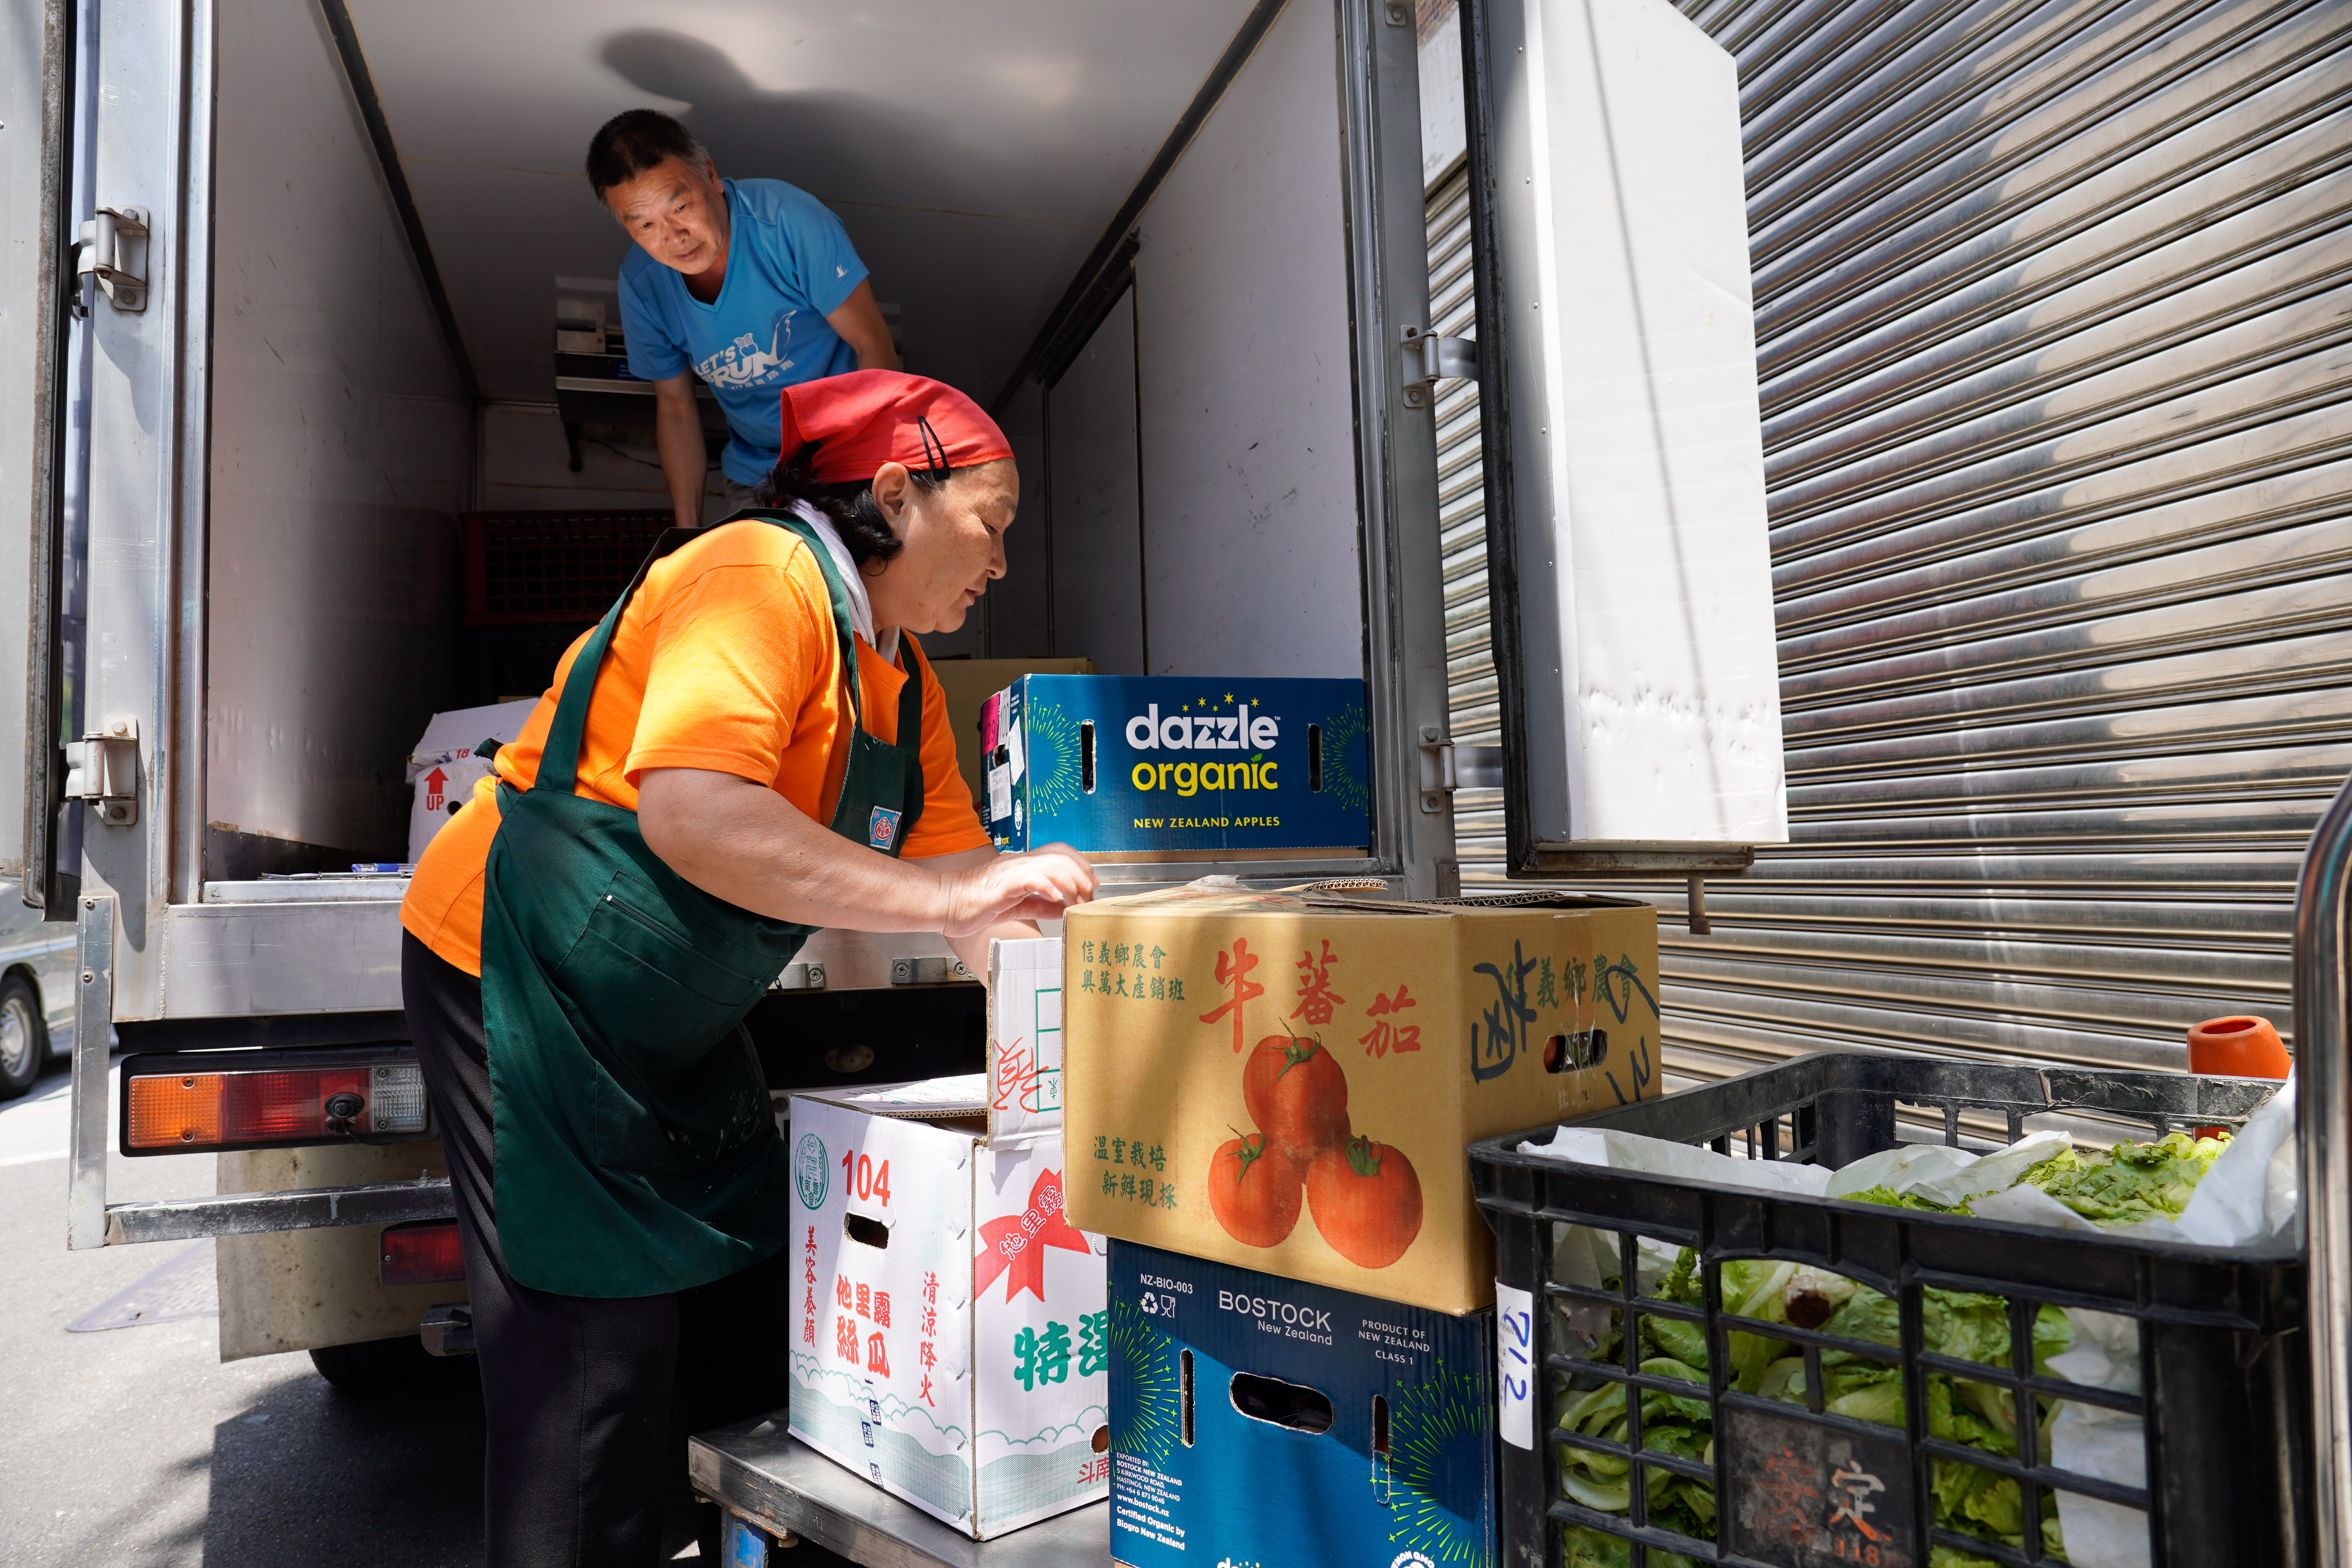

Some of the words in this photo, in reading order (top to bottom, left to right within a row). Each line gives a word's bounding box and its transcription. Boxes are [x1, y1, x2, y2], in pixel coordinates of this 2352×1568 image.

[695, 346, 735, 376] LET'S
[1126, 703, 1279, 750] dazzle
[457, 749, 470, 759] 18
[1132, 753, 1278, 797] organic
[427, 796, 444, 810] UP
[1134, 818, 1164, 829] NEW
[1170, 817, 1229, 828] ZEALAND
[1235, 816, 1280, 827] APPLES
[1082, 940, 1167, 970] 信義鄉農會
[1082, 969, 1185, 1001] 奧萬大產銷班
[1200, 937, 1421, 1059] 牛蕃茄
[1094, 1136, 1167, 1171] 溫室栽培
[842, 1149, 890, 1207] 104
[1102, 1169, 1178, 1210] 新鮮現採
[804, 1225, 817, 1348] 美容養顏
[1140, 1273, 1193, 1294] NZ-BIO-003
[1219, 1290, 1332, 1332] BOSTOCK
[919, 1271, 940, 1408] 清涼降火
[1258, 1320, 1281, 1334] New
[1285, 1326, 1332, 1346] Zealand
[1359, 1330, 1380, 1342] NEW
[1384, 1336, 1430, 1352] ZEALAND
[1362, 1319, 1408, 1336] PRODUCT
[1412, 1329, 1425, 1339] OF
[837, 1314, 890, 1379] 絲瓜
[1375, 1350, 1405, 1363] CLASS
[1409, 1357, 1413, 1365] 1
[1116, 1452, 1141, 1465] EXPORTED
[1117, 1460, 1142, 1473] BOSTOCK
[1143, 1468, 1156, 1477] NEW
[1157, 1472, 1182, 1486] ZEALAND
[1121, 1470, 1149, 1483] KIRKWOOD
[1150, 1479, 1165, 1489] ROAD,
[1117, 1475, 1143, 1489] HASTINGS,
[1144, 1484, 1156, 1493] NEW
[1157, 1488, 1180, 1501] ZEALAND
[1151, 1495, 1165, 1504] 9046
[1117, 1493, 1169, 1517] www.bostock.nz
[1117, 1506, 1146, 1523] Certified
[1147, 1516, 1174, 1533] Organic
[1176, 1526, 1185, 1538] by
[1117, 1518, 1140, 1533] Biogro
[1140, 1526, 1156, 1539] New
[1157, 1532, 1185, 1550] Zealand
[1394, 1551, 1413, 1566] NON
[1413, 1551, 1435, 1568] GMO
